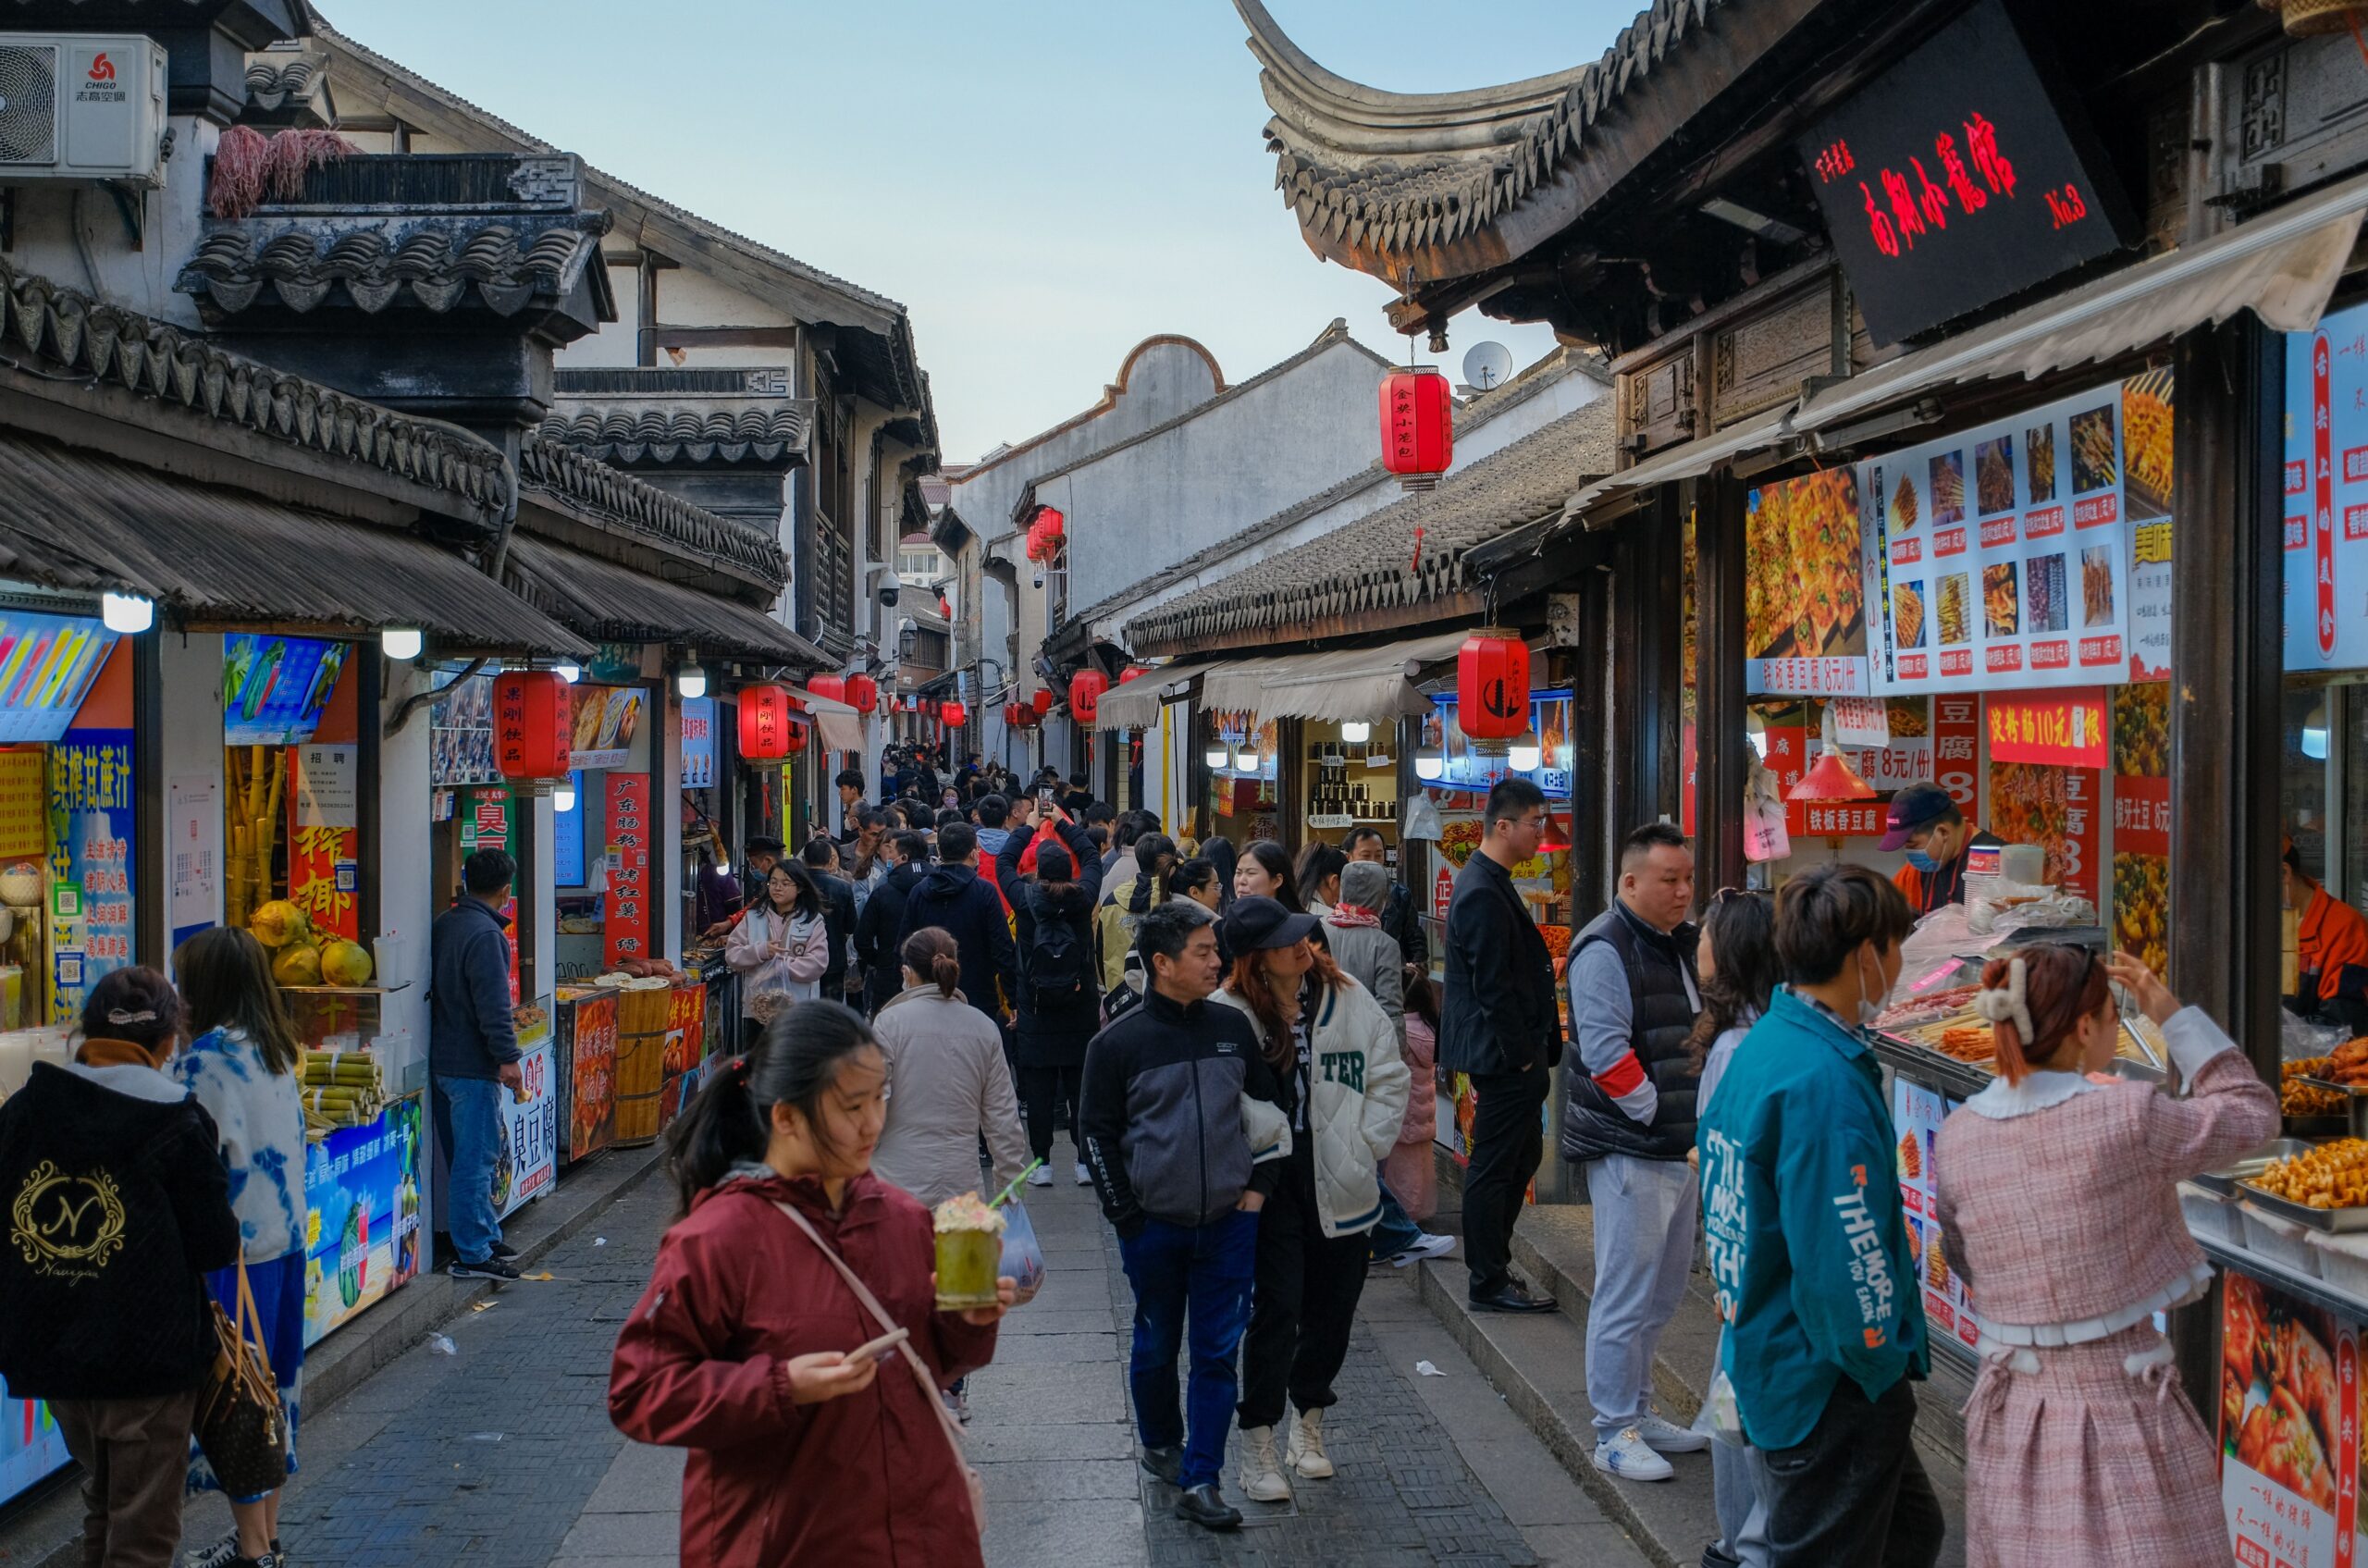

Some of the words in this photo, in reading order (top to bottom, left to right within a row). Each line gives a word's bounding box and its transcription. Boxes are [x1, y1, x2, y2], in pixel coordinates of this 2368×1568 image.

[76, 92, 126, 102] 志高空调
[2044, 183, 2086, 229] No.3
[2315, 352, 2333, 636] 舌尖上的美食
[1764, 658, 1819, 691] 铁板香豆腐
[53, 745, 130, 809] 鲜榨甘蔗汁
[310, 752, 345, 764] 招聘
[1881, 747, 1930, 780] 8元/份
[614, 780, 643, 848] 广东肠粉
[1810, 809, 1877, 832] 铁板香豆腐
[667, 988, 701, 1029] 烤红薯
[1320, 1051, 1365, 1093] TER
[513, 1095, 554, 1180] 臭豆腐
[1833, 1188, 1881, 1254] THE
[1848, 1257, 1865, 1282] YOU
[1862, 1246, 1894, 1322] MORE
[1856, 1286, 1876, 1324] EARN
